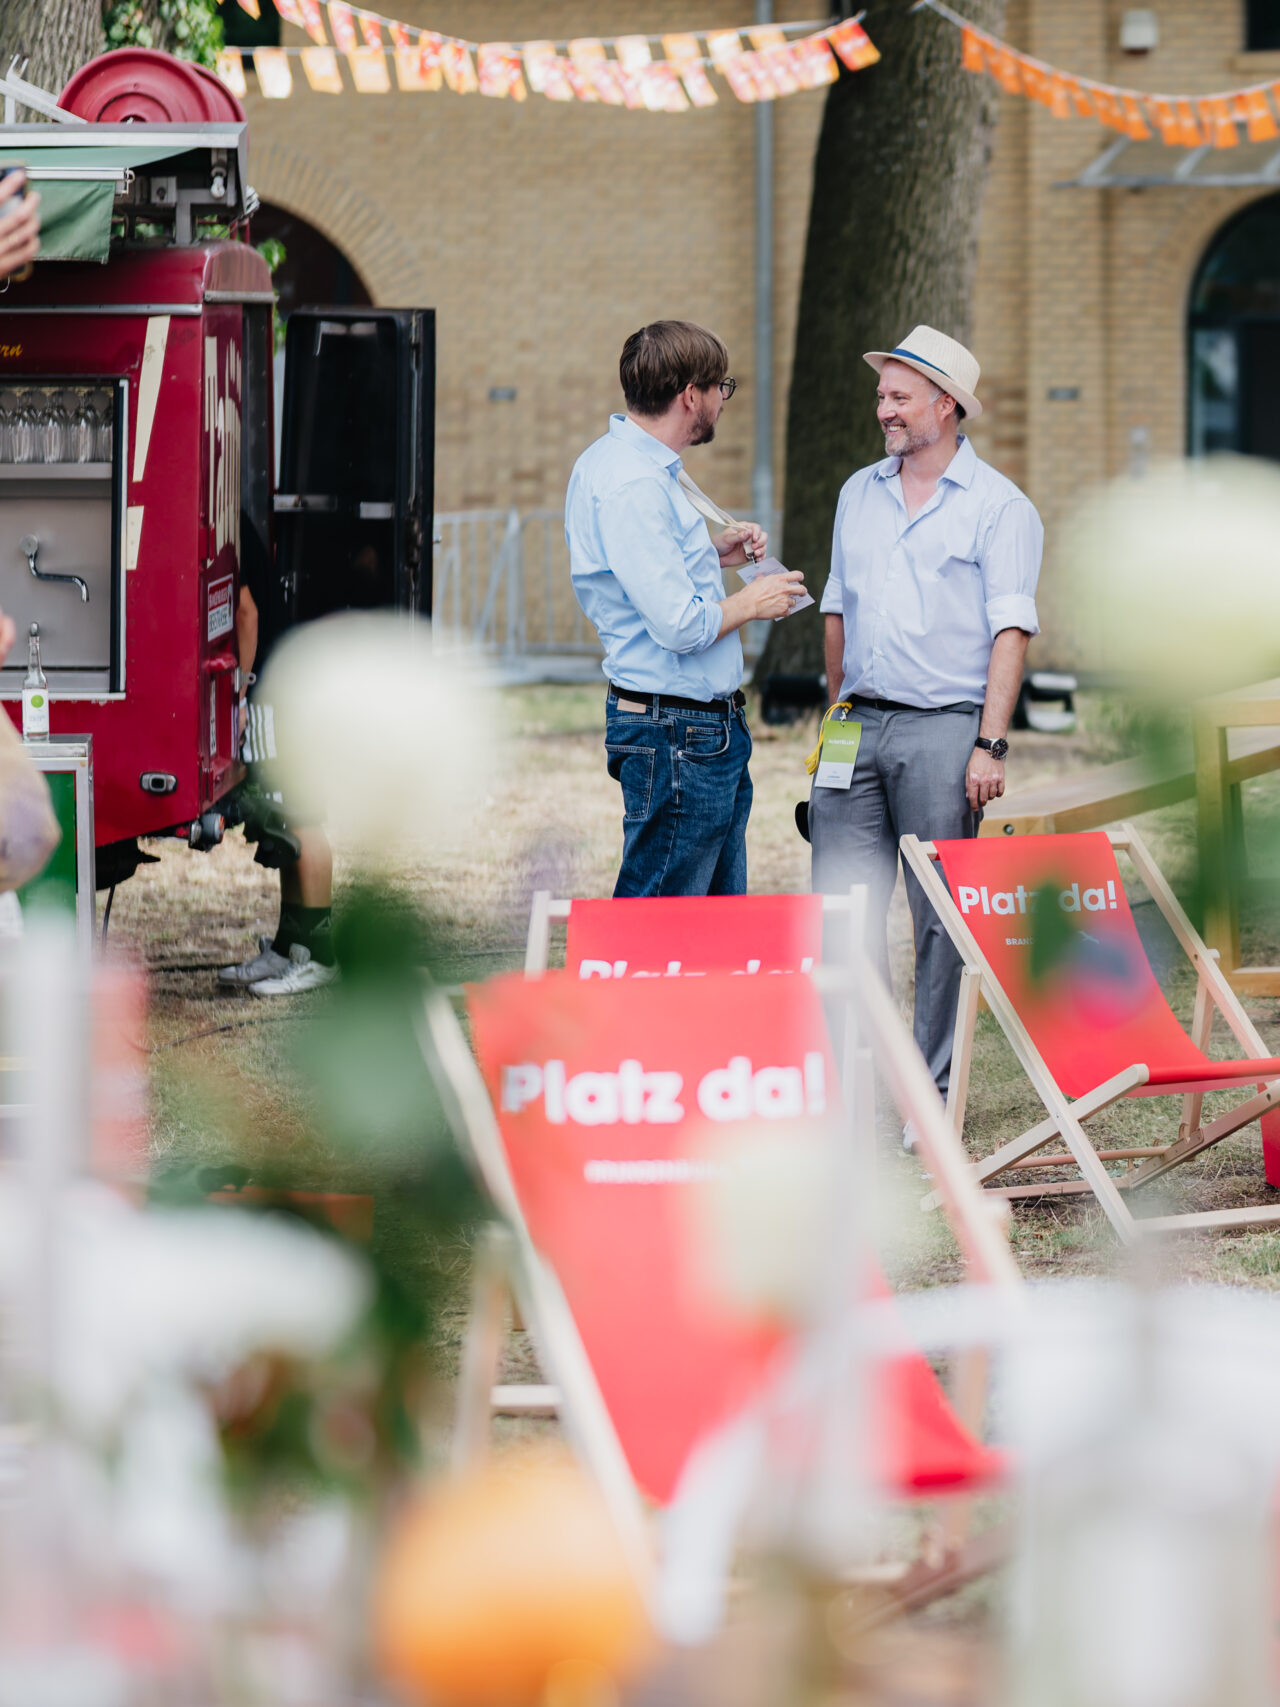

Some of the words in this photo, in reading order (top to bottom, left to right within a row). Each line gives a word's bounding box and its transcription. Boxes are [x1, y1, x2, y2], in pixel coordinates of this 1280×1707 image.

[1058, 879, 1118, 912] da!
[501, 1059, 685, 1126] Platz
[697, 1051, 827, 1123] da!
